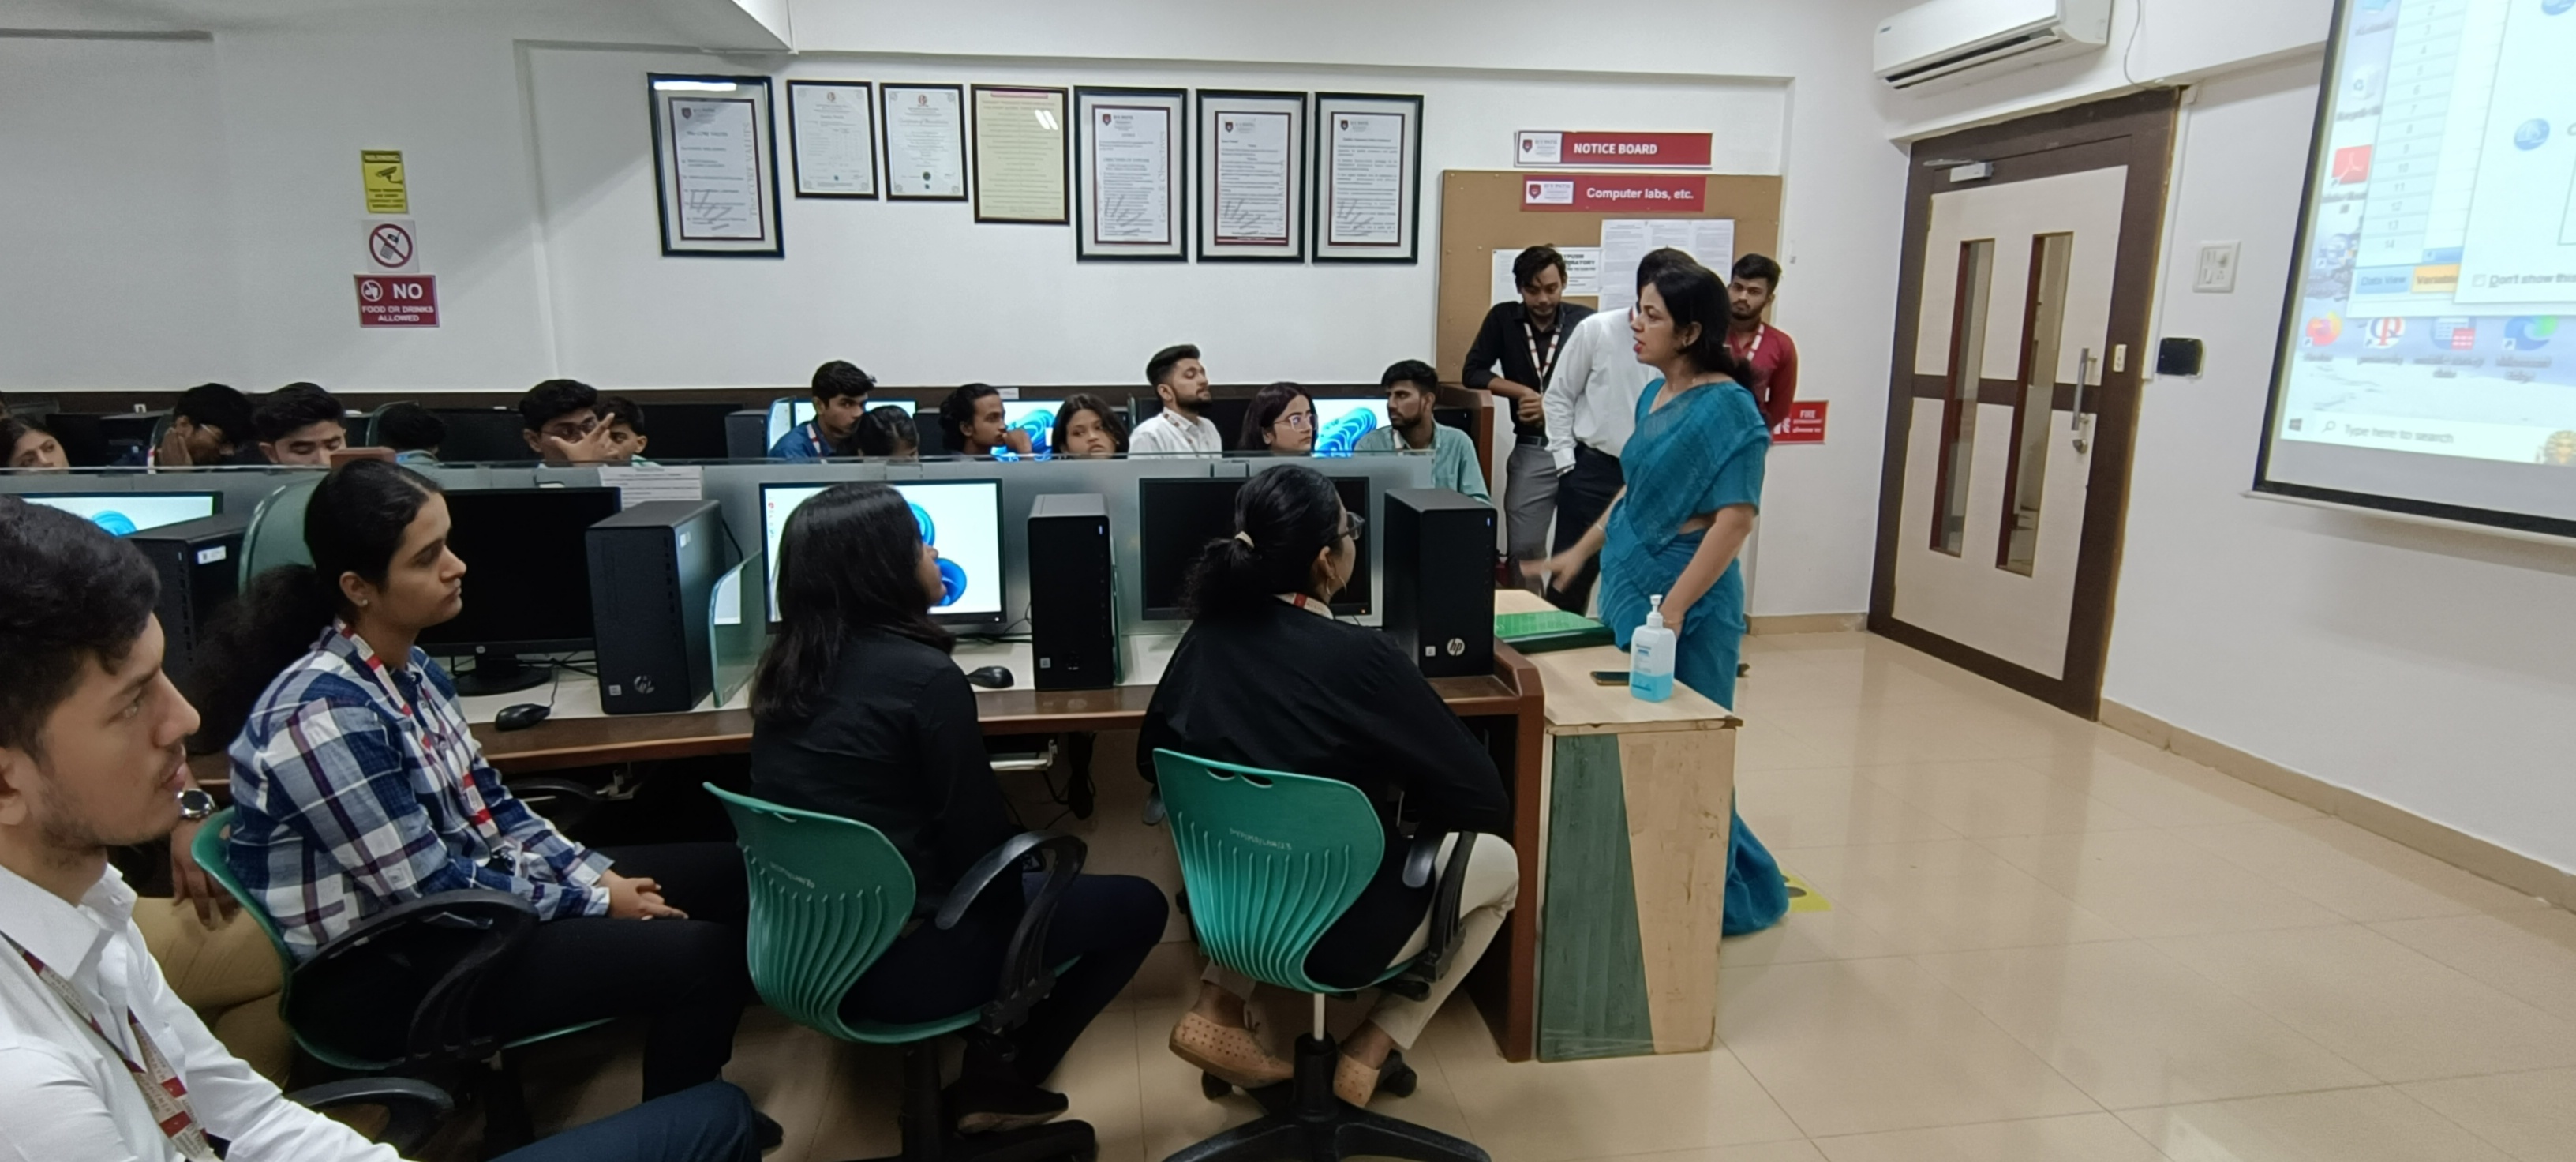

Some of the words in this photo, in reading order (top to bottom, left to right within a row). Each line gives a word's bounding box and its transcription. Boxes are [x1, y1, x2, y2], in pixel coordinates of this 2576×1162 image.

[1574, 143, 1616, 154] NOTICE
[1618, 144, 1657, 154] BOARD
[1586, 187, 1642, 201] Computer
[1644, 189, 1671, 200] labs,
[1674, 189, 1694, 199] etc.
[2384, 240, 2395, 249] 14
[2361, 276, 2382, 286] Data
[2385, 276, 2407, 284] View
[2488, 274, 2519, 288] Don't
[2521, 275, 2554, 284] show
[393, 283, 423, 299] NO
[1800, 410, 1816, 418] FIRE
[2345, 424, 2370, 437] Type
[2372, 427, 2397, 439] here
[2399, 430, 2413, 440] to
[2414, 432, 2454, 443] search
[1447, 638, 1465, 656] hp
